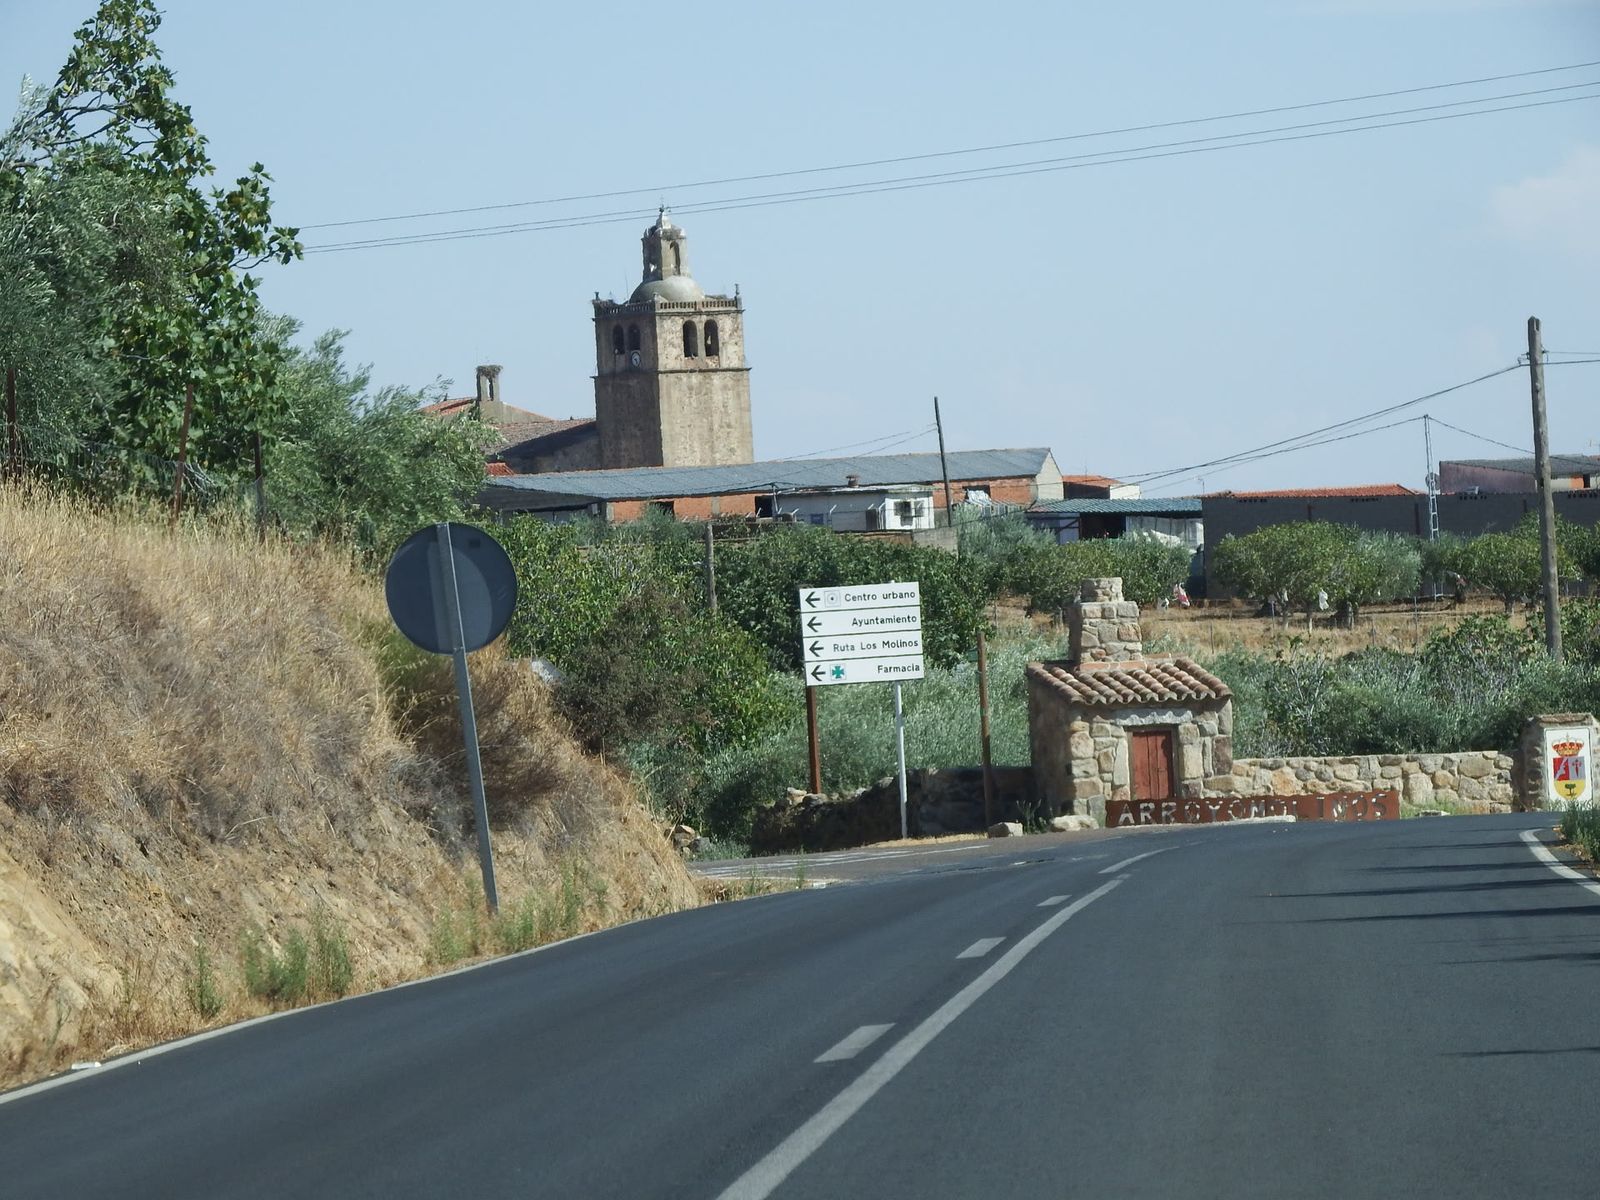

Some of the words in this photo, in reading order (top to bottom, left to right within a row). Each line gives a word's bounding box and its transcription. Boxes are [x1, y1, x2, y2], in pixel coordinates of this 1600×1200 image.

[844, 593, 877, 602] Centro
[882, 591, 916, 600] urbano
[851, 614, 917, 627] Ayuntamiento
[833, 643, 855, 652] Ruta
[860, 642, 877, 650] Los
[882, 639, 919, 649] Molinos
[877, 663, 920, 674] Farmacia
